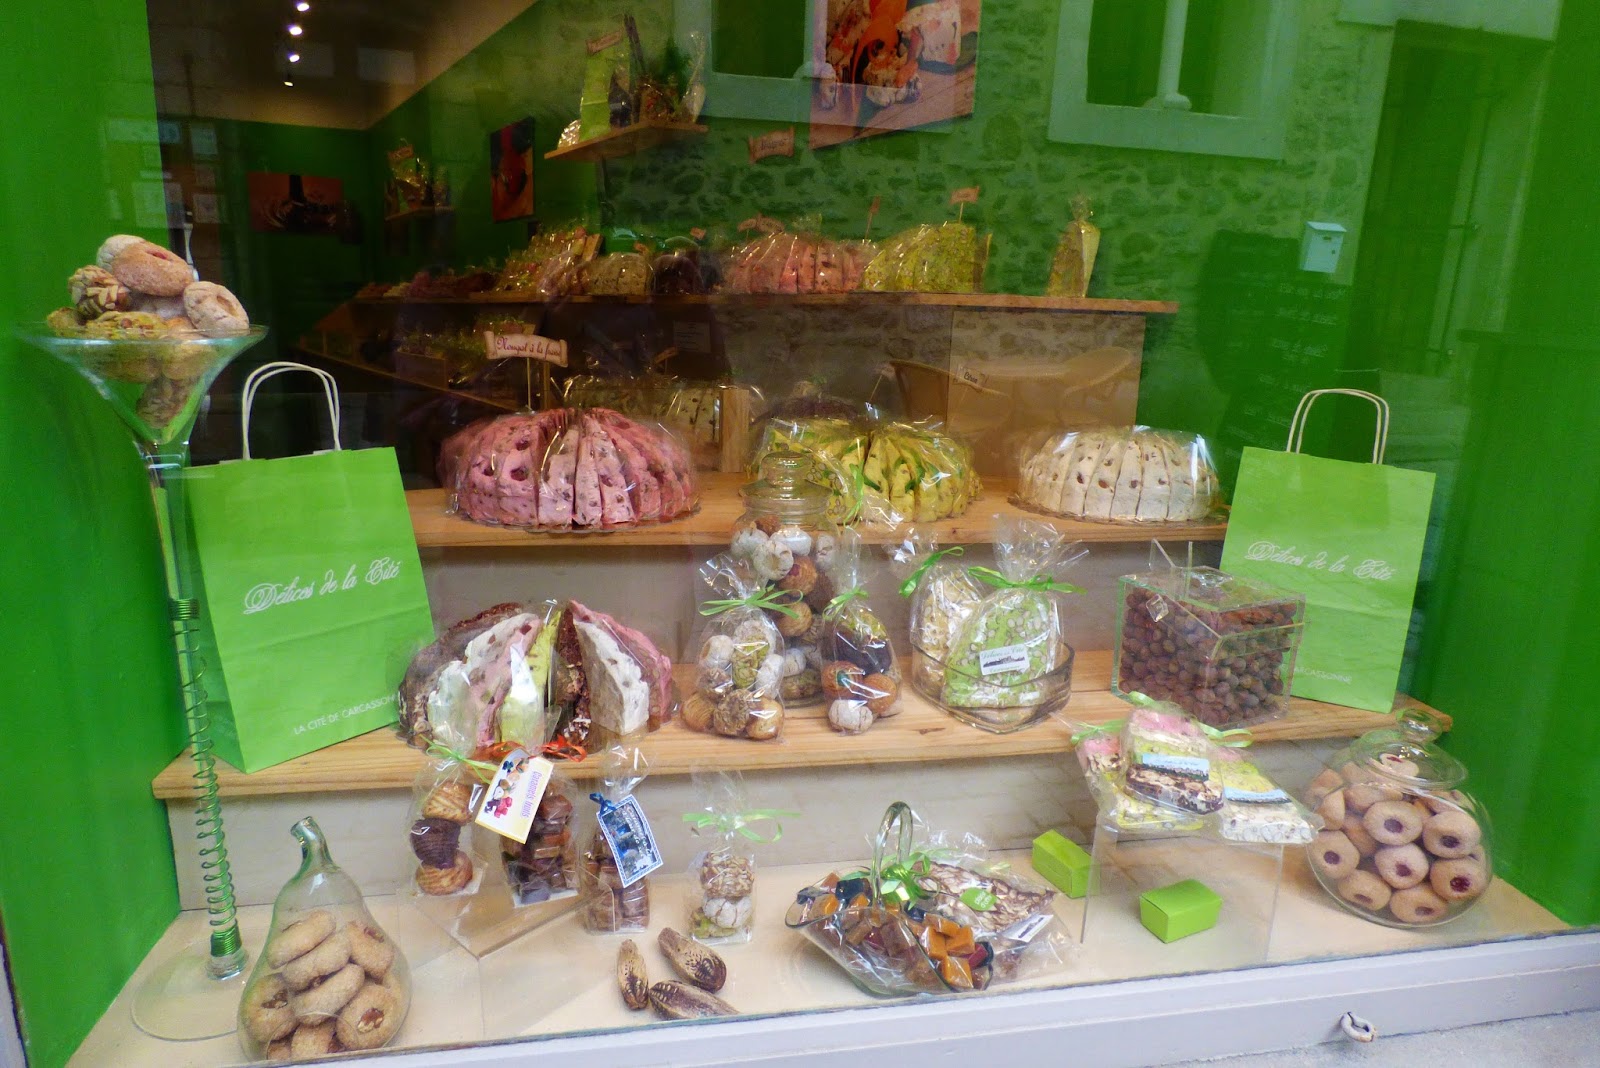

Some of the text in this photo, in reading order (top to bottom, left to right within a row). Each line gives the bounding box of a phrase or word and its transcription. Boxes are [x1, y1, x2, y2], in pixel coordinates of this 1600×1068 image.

[320, 569, 338, 595] de
[342, 564, 357, 590] la
[365, 557, 401, 585] Cité
[1308, 551, 1328, 569] de
[1329, 555, 1350, 572] la
[1292, 666, 1352, 684] ARCASSONNE
[294, 724, 306, 735] LA
[328, 713, 339, 724] DE
[341, 694, 395, 718] CARCASSON
